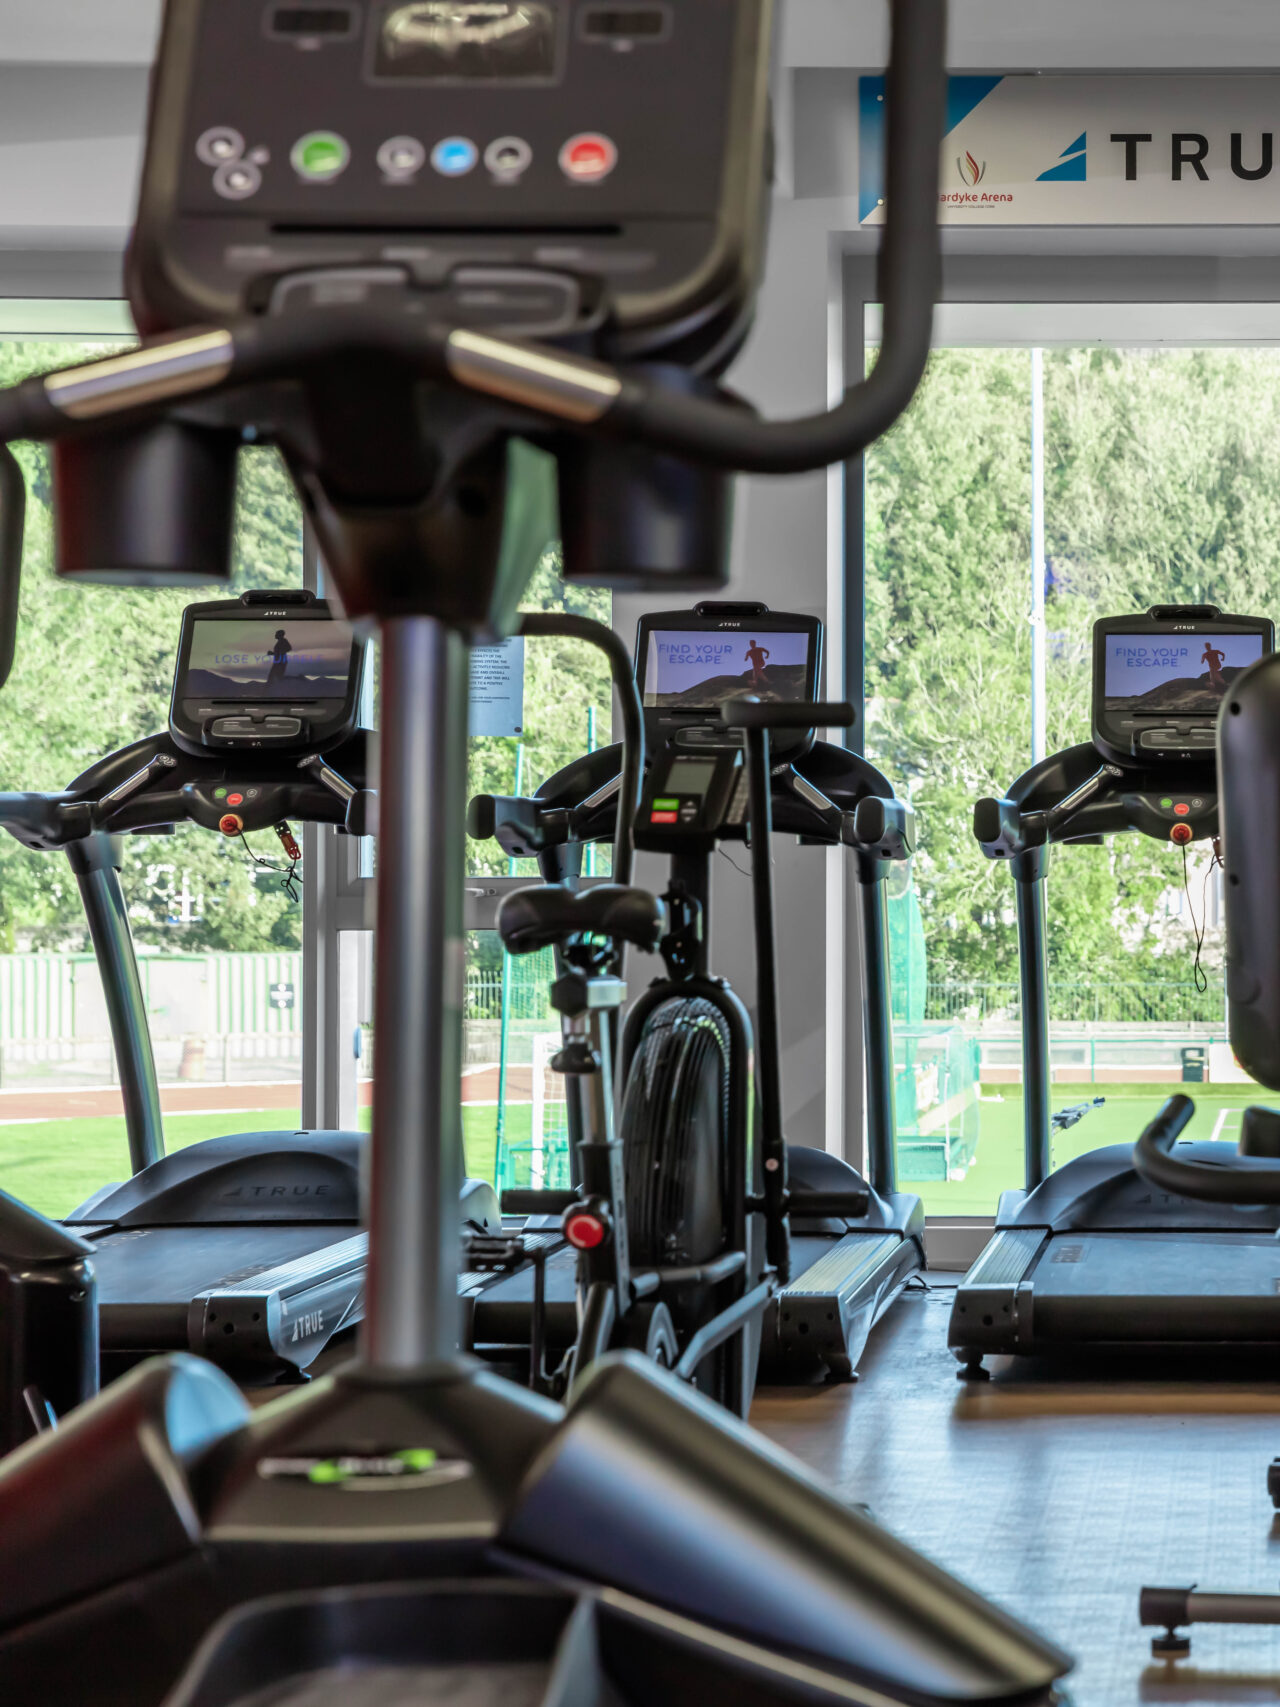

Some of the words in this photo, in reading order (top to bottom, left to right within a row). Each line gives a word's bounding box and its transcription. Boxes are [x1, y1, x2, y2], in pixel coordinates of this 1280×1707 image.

[938, 192, 978, 204] ardyke
[981, 193, 1013, 202] Arena
[658, 644, 690, 654] FIND
[695, 645, 732, 654] YOUR
[1115, 648, 1147, 657] FIND
[1151, 648, 1188, 657] YOUR
[215, 654, 248, 664] LOSE
[251, 1185, 330, 1197] TRUE
[299, 1309, 324, 1339] TRUE
